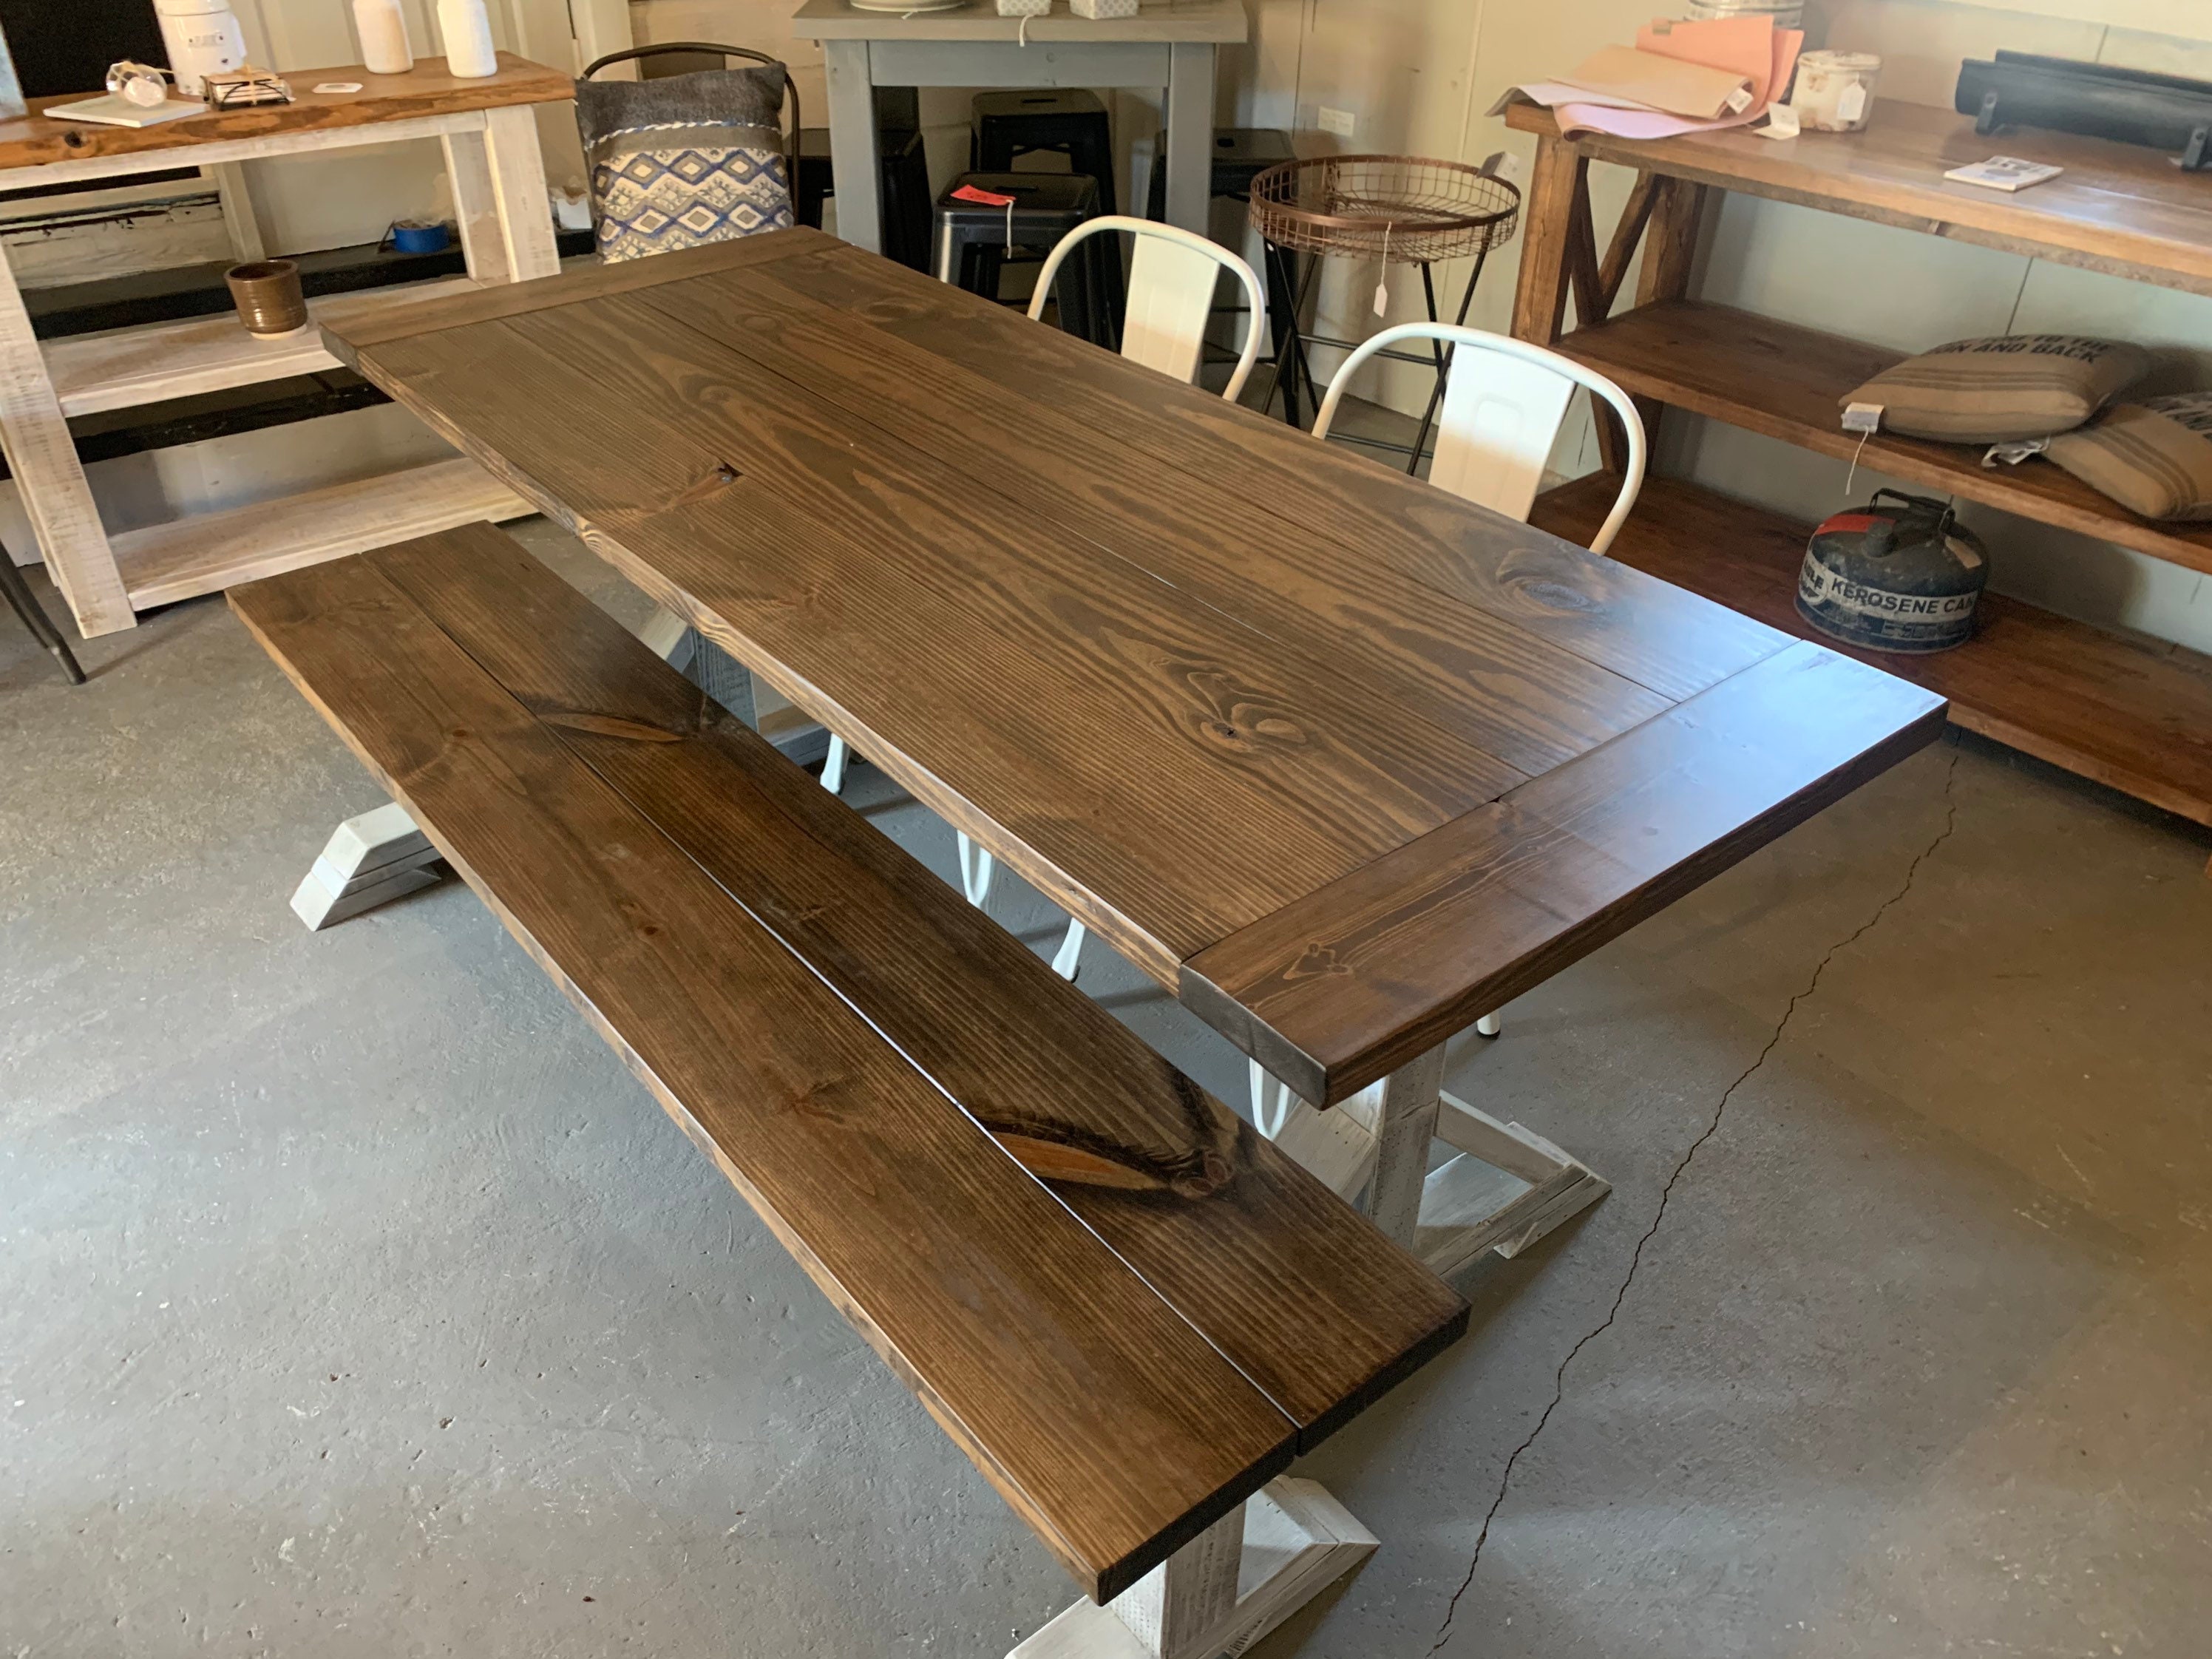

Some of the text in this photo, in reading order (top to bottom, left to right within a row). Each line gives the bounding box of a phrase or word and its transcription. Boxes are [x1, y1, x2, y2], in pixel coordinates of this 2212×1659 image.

[1972, 342, 2028, 353] AND
[2030, 344, 2101, 363] BACK
[1832, 578, 1940, 614] KEROSENE
